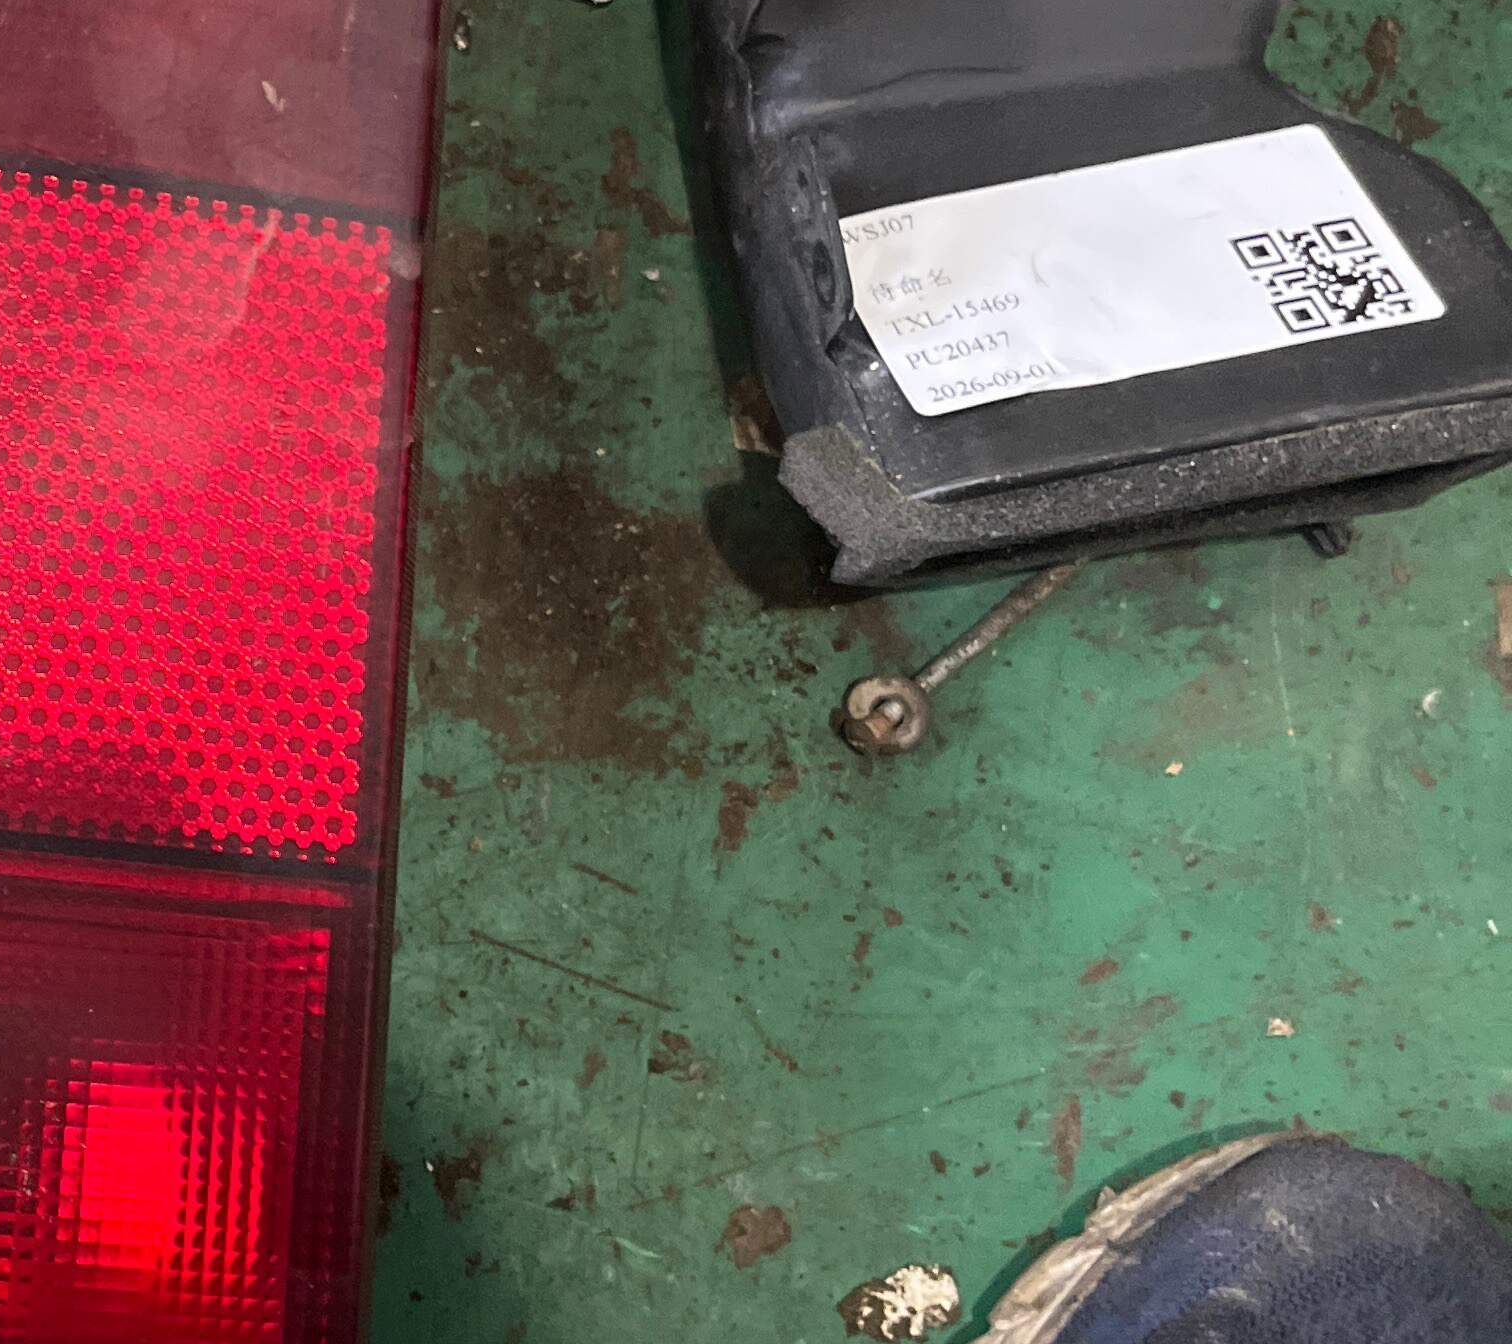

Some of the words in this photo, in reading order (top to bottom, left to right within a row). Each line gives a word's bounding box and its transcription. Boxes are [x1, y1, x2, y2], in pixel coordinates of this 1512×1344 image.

[886, 292, 1021, 336] TXL-15469
[905, 330, 1011, 370] PU20437
[927, 360, 1058, 403] 2026-09-01
